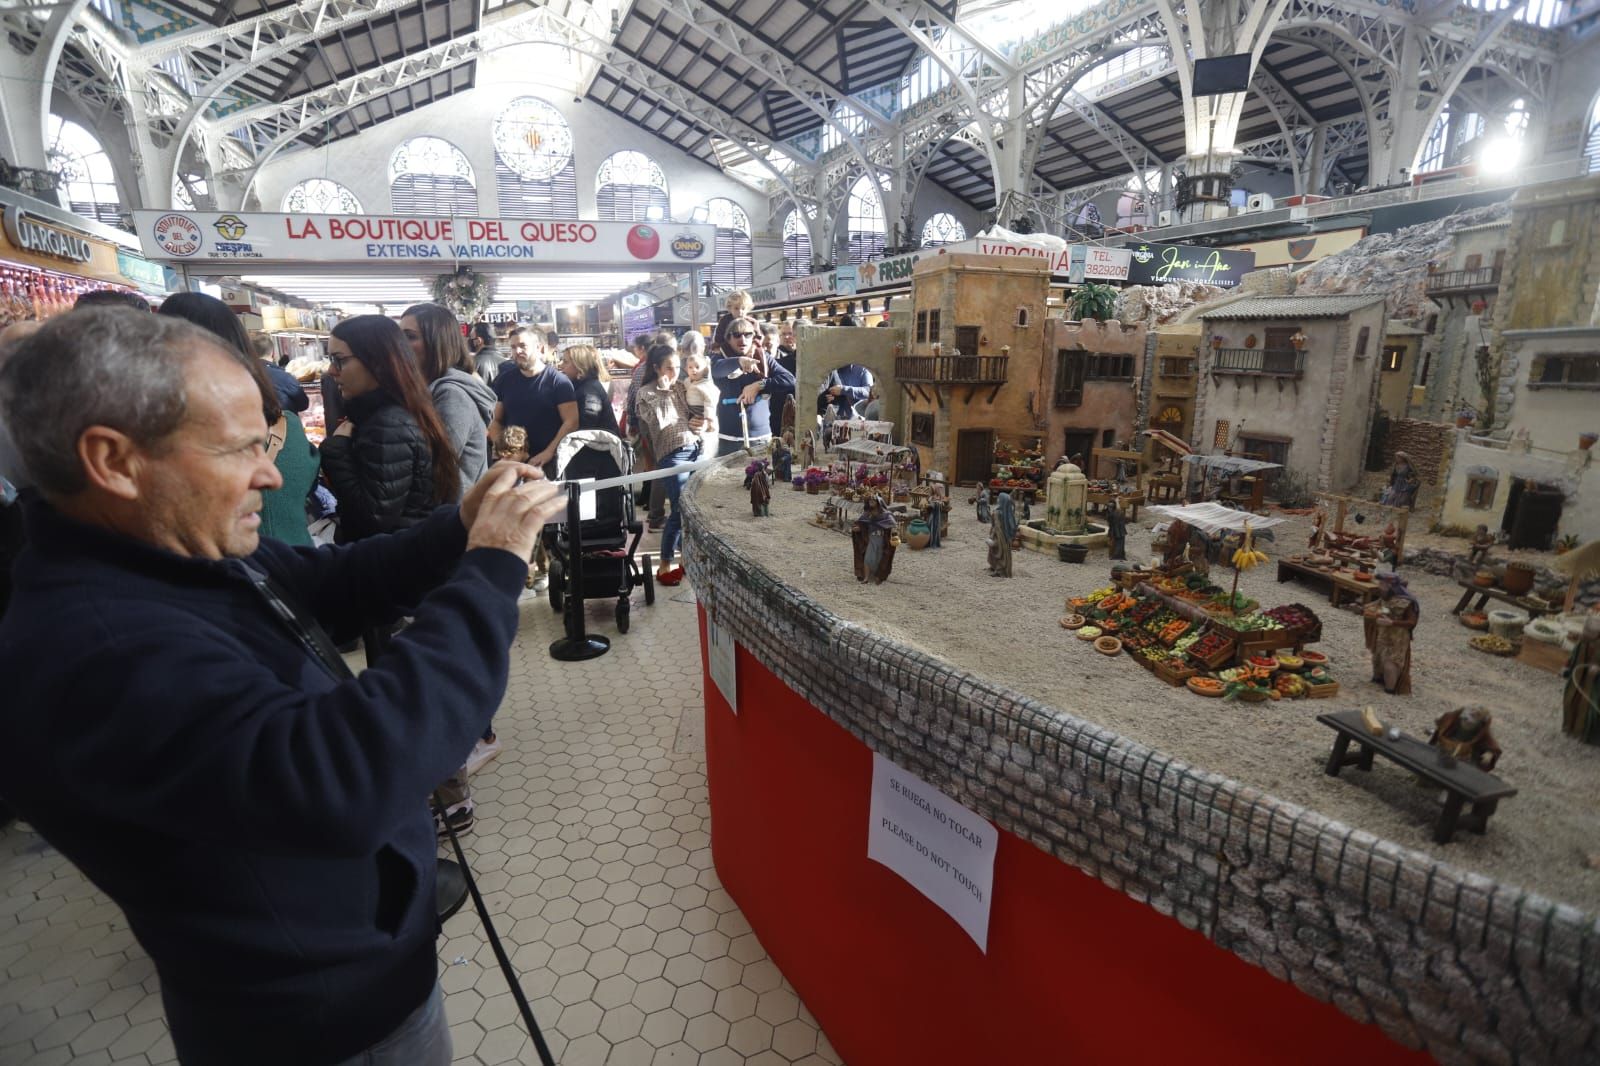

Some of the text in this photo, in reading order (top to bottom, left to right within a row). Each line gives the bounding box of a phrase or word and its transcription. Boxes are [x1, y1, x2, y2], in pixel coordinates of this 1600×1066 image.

[286, 217, 597, 243] LA BOUTIQUE DEL QUESO
[366, 244, 534, 258] EXTENSA VARIACION
[1086, 263, 1129, 277] 3829206
[889, 778, 983, 849] SE RUEGA NO TOCAR
[881, 817, 983, 903] PLEASE DO NOT TOUCH
